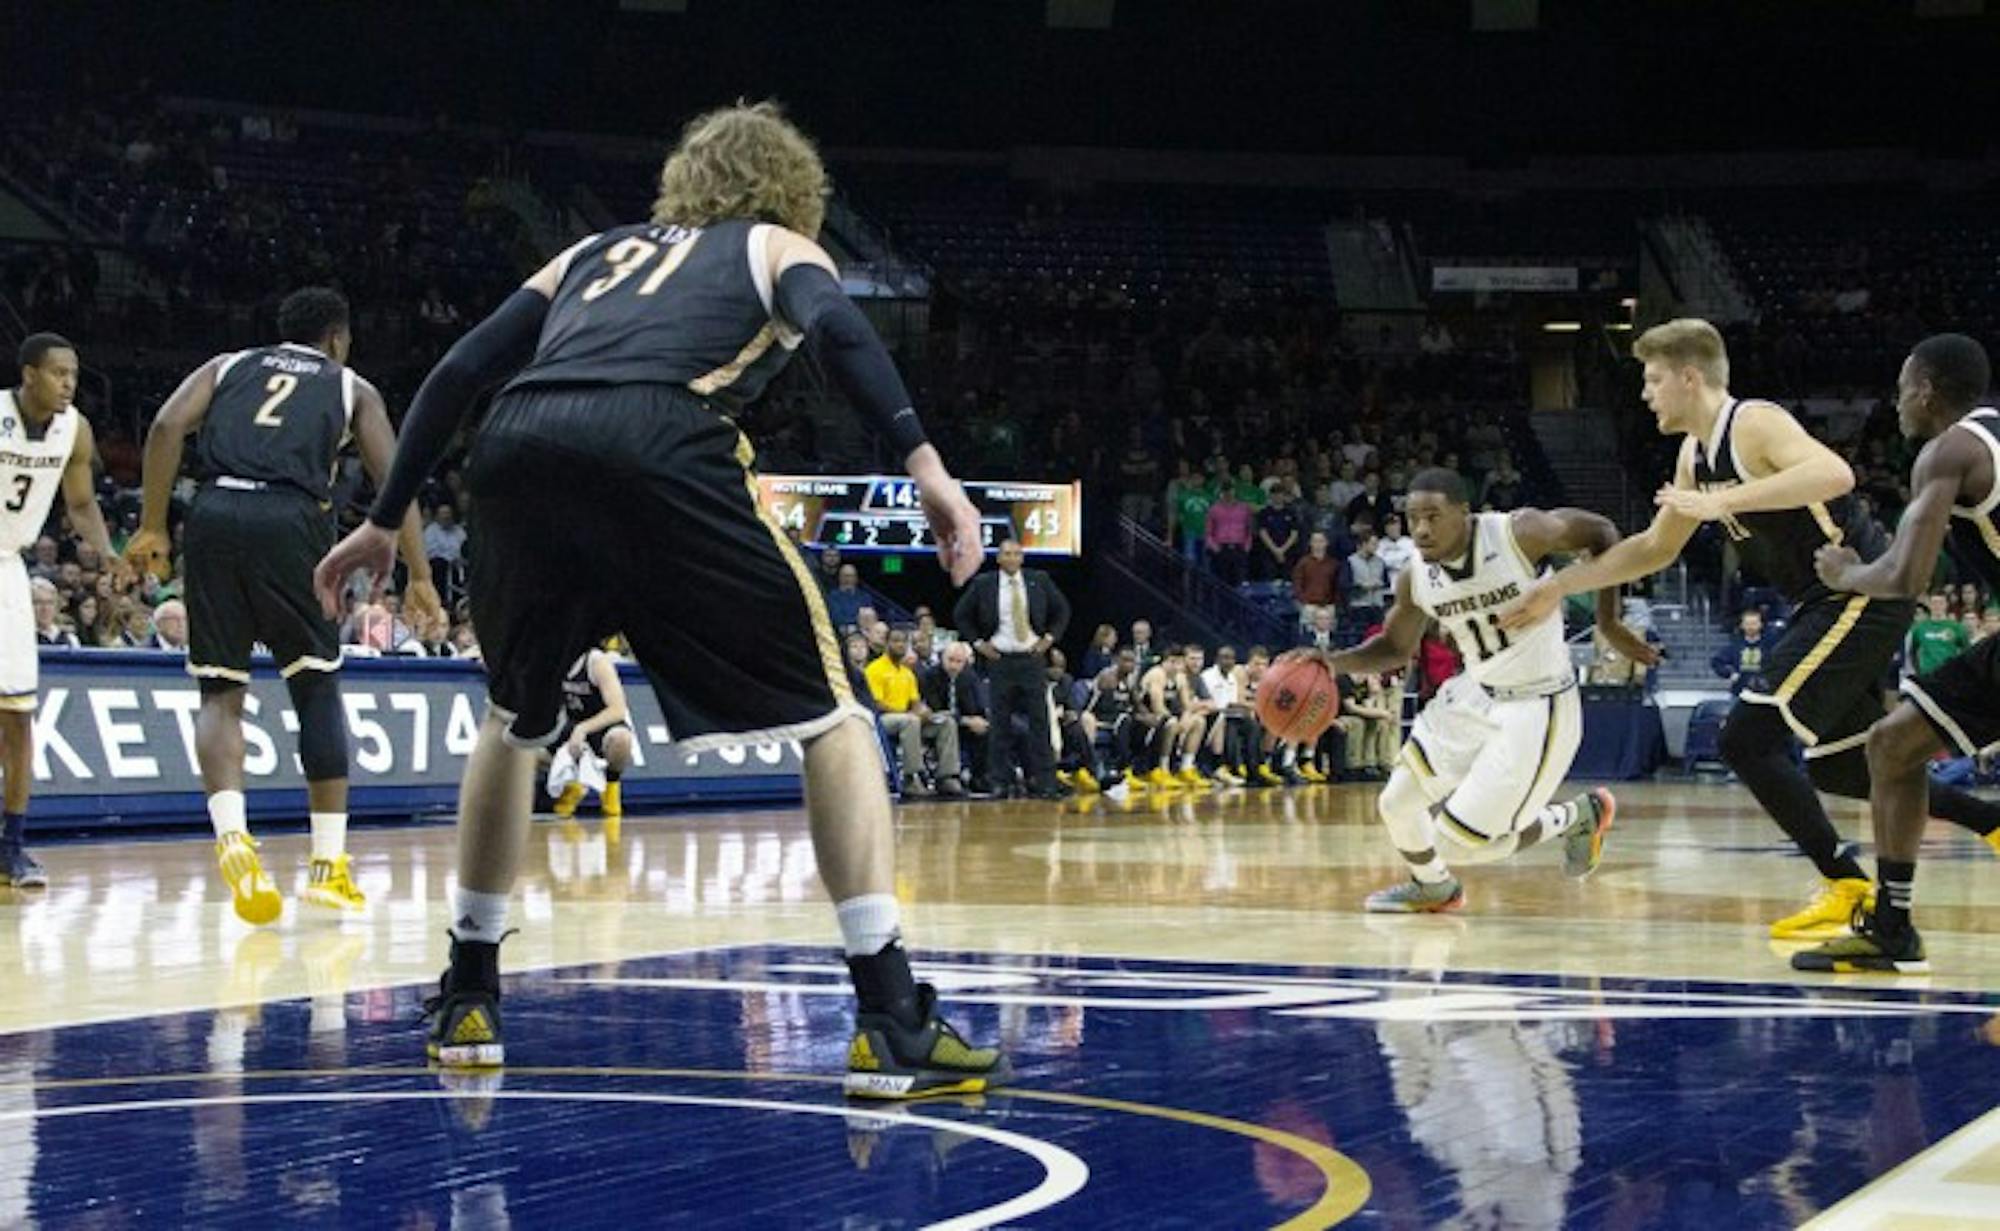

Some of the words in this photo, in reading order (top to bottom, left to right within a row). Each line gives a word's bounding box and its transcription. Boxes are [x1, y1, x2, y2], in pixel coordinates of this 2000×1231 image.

[582, 234, 701, 301] 31
[254, 374, 298, 427] 2
[6, 474, 32, 511] 3
[882, 483, 921, 508] 14:
[1024, 508, 1059, 535] 43
[1433, 596, 1476, 618] NOTRE
[1479, 582, 1521, 607] DAME
[1466, 613, 1510, 662] 11
